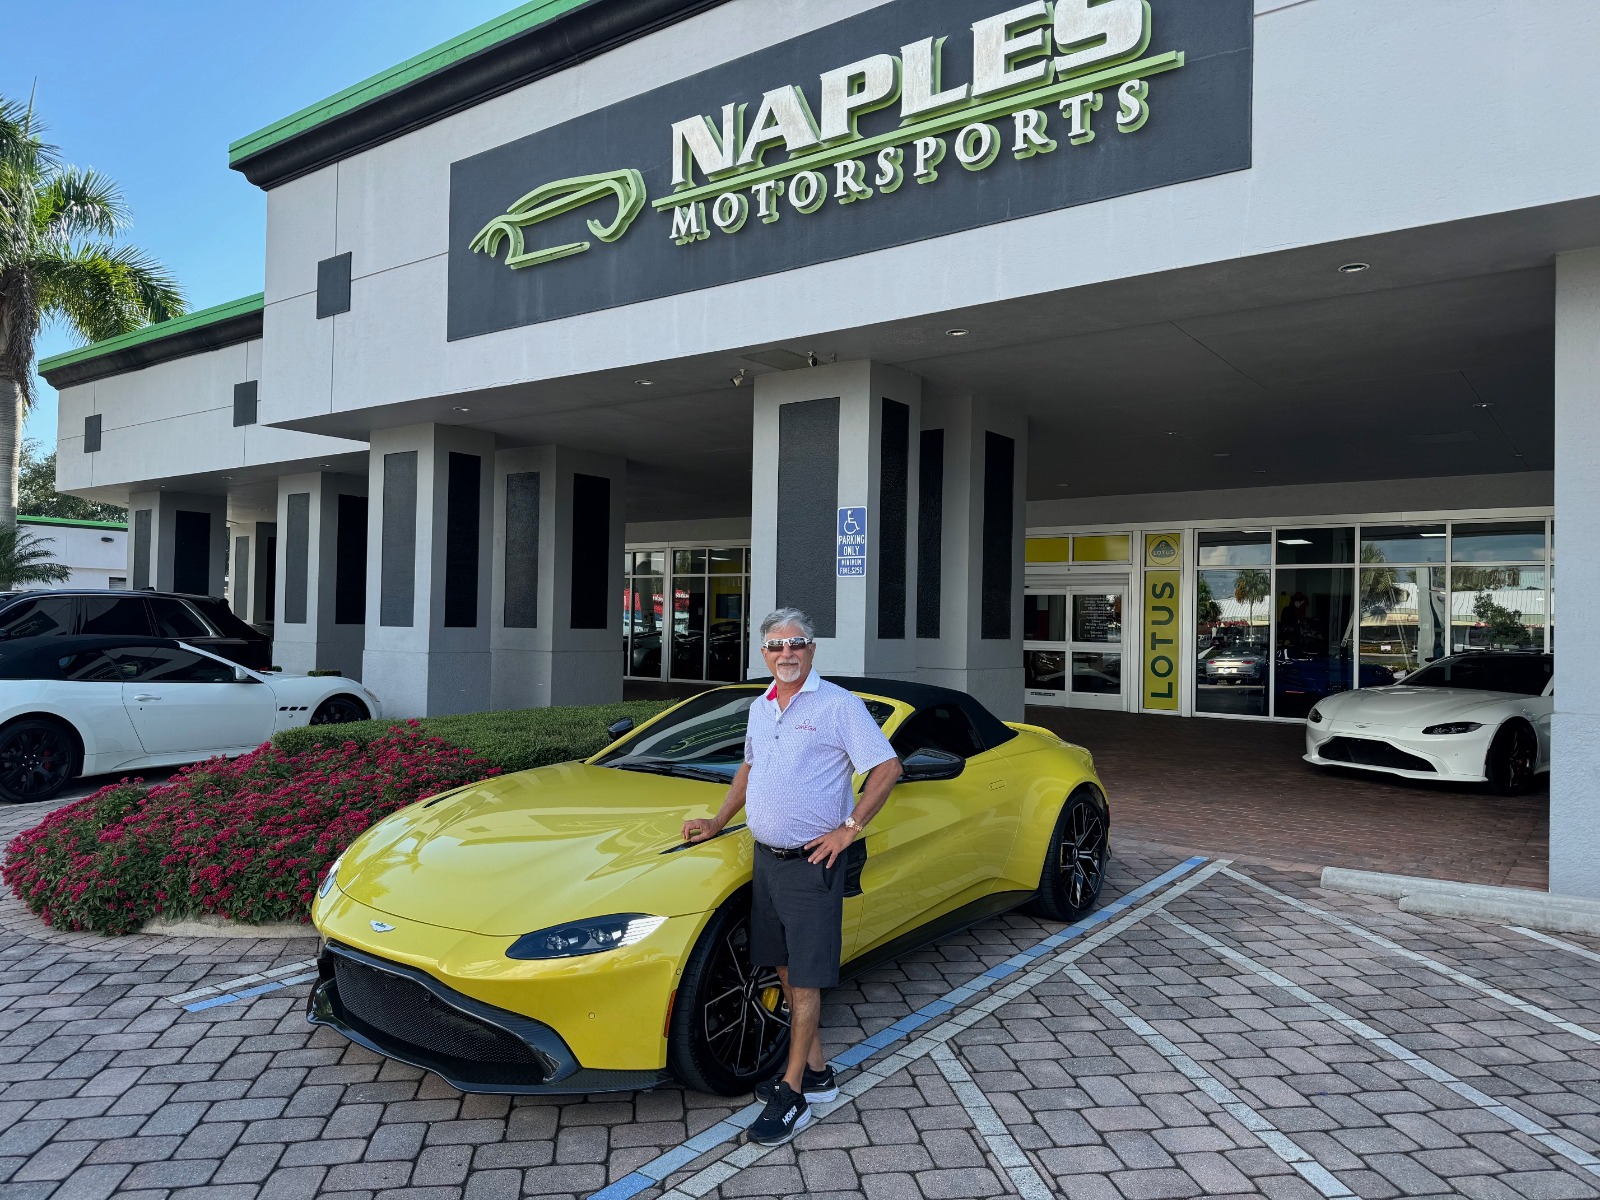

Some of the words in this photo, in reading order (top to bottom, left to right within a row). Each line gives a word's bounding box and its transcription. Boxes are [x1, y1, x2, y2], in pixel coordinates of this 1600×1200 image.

[671, 0, 1150, 188] NAPLES
[669, 79, 1149, 245] MOTORSPORTS
[838, 534, 864, 545] PARKING
[844, 546, 860, 555] ONLY
[1150, 581, 1176, 699] LOTUS
[782, 1105, 798, 1126] HOKA
